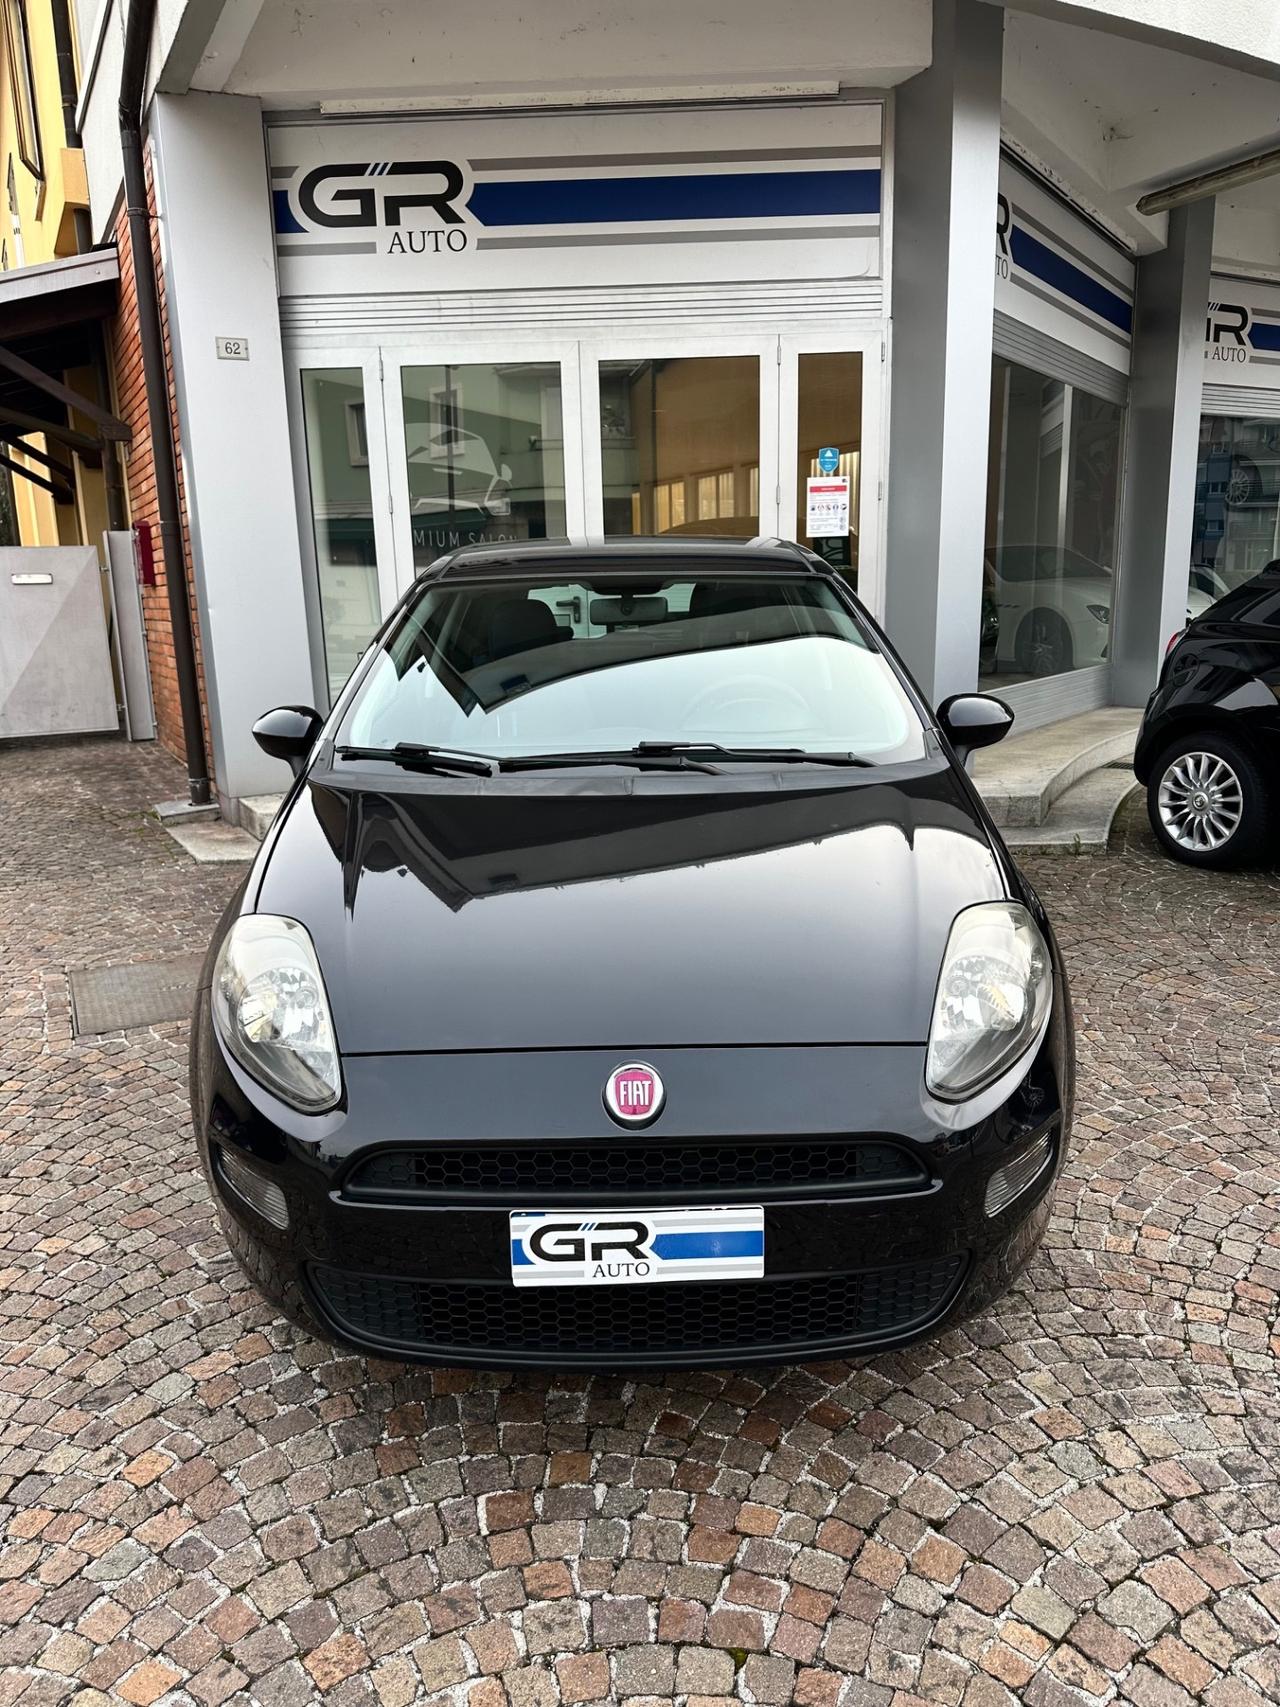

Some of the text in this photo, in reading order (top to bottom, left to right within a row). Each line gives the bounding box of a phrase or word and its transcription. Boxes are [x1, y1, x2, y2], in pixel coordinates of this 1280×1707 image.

[298, 160, 466, 228] GR
[387, 228, 468, 254] AUTO
[995, 254, 1009, 279] TO
[224, 341, 241, 355] 62
[1211, 346, 1247, 363] AUTO
[413, 529, 460, 548] MIUM
[619, 1080, 652, 1106] FIAT
[529, 1220, 650, 1262] GR
[591, 1261, 650, 1278] AUTO
